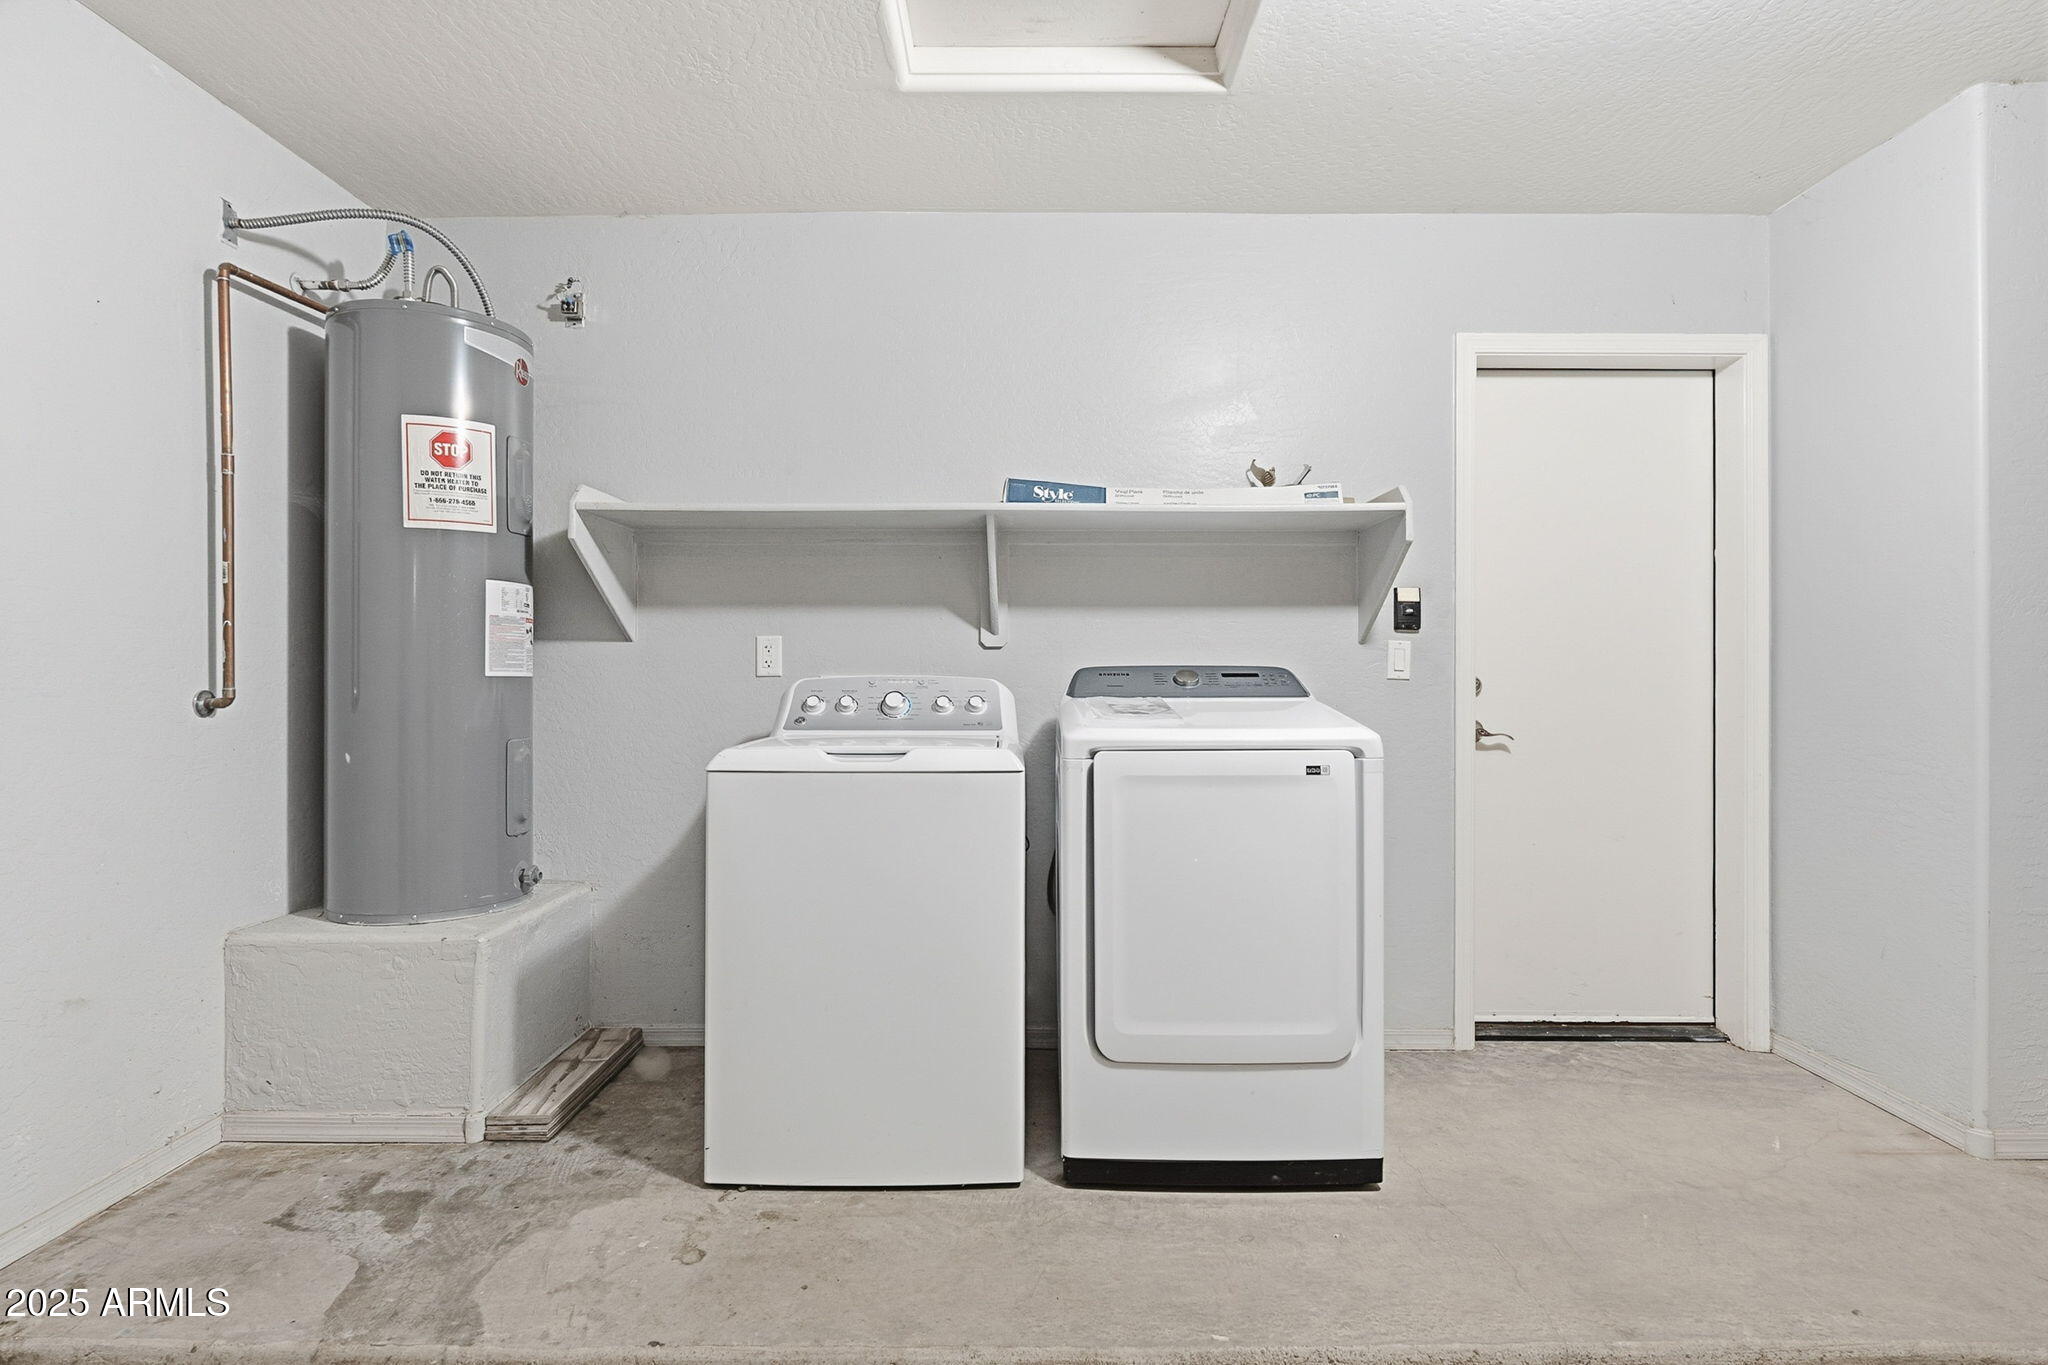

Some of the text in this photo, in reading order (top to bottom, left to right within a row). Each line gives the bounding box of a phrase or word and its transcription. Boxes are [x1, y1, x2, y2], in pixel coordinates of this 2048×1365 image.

[433, 442, 468, 458] STOP
[444, 471, 468, 479] RETN
[447, 478, 470, 486] HEATER
[458, 486, 487, 494] PURCHASE
[1033, 485, 1074, 502] Style
